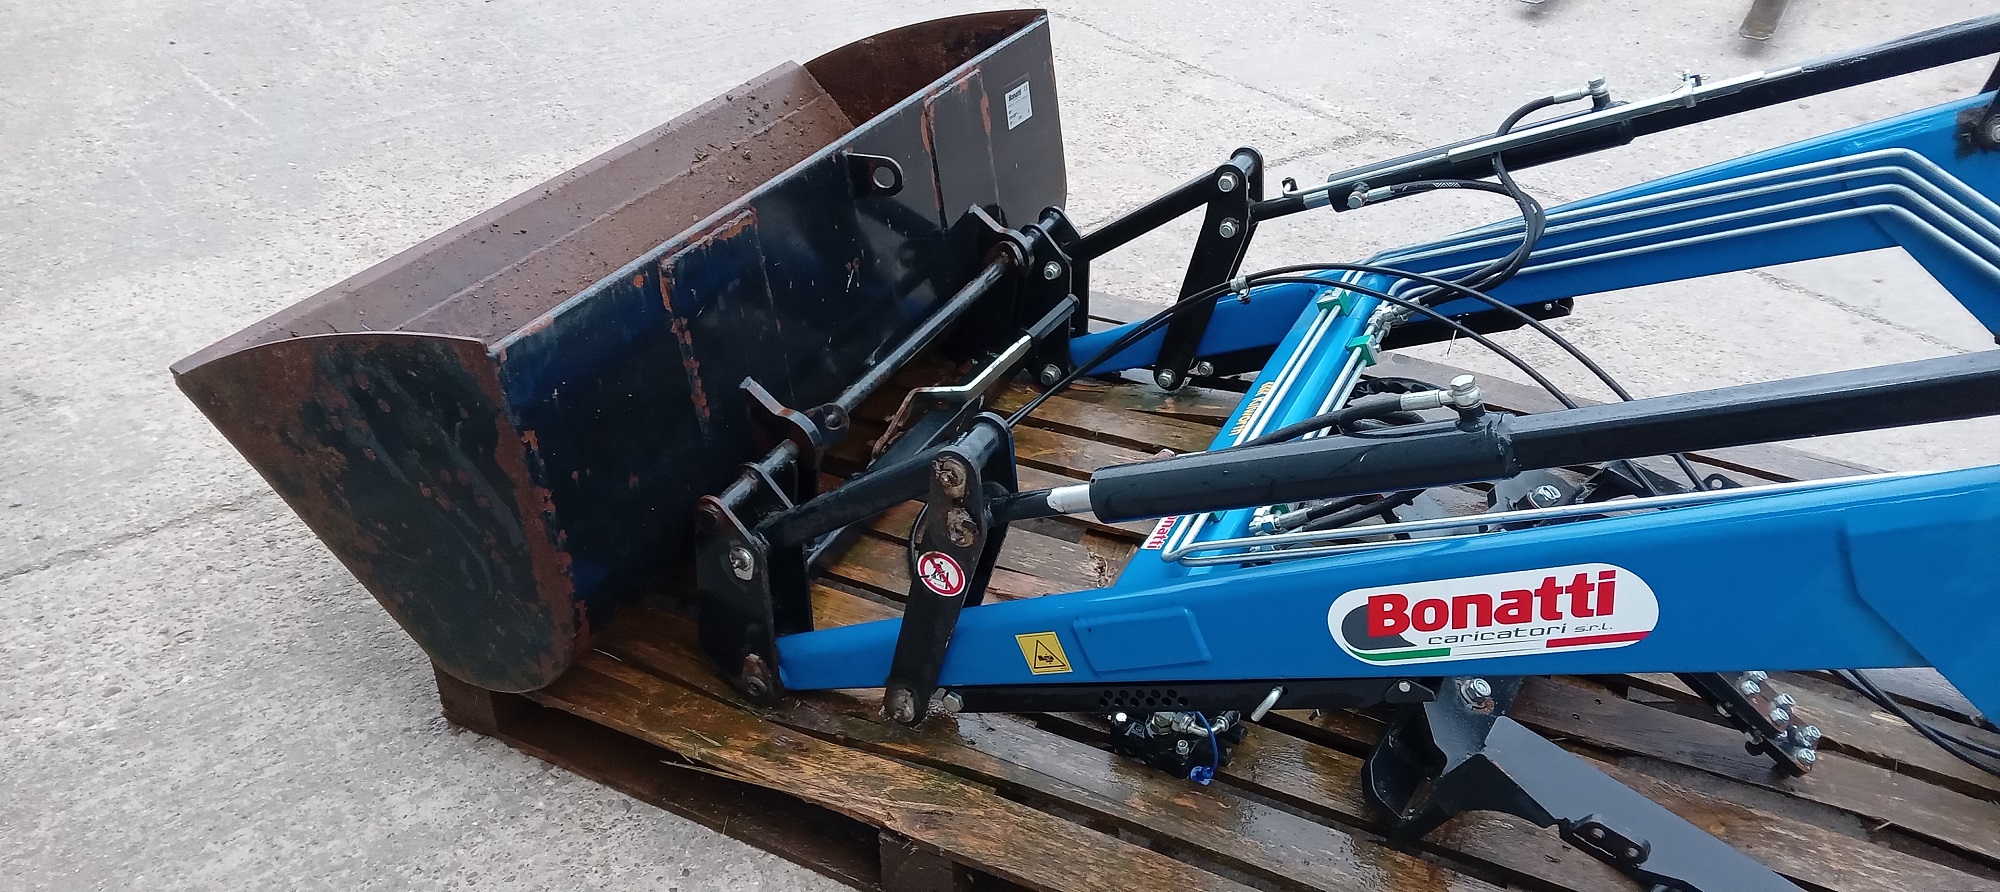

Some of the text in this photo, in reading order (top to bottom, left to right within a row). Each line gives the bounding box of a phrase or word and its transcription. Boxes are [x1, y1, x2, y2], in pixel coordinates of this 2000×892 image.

[1147, 515, 1177, 549] natti
[1367, 569, 1616, 638] Bonatti
[1428, 622, 1613, 646] caricatori s.r.l.
